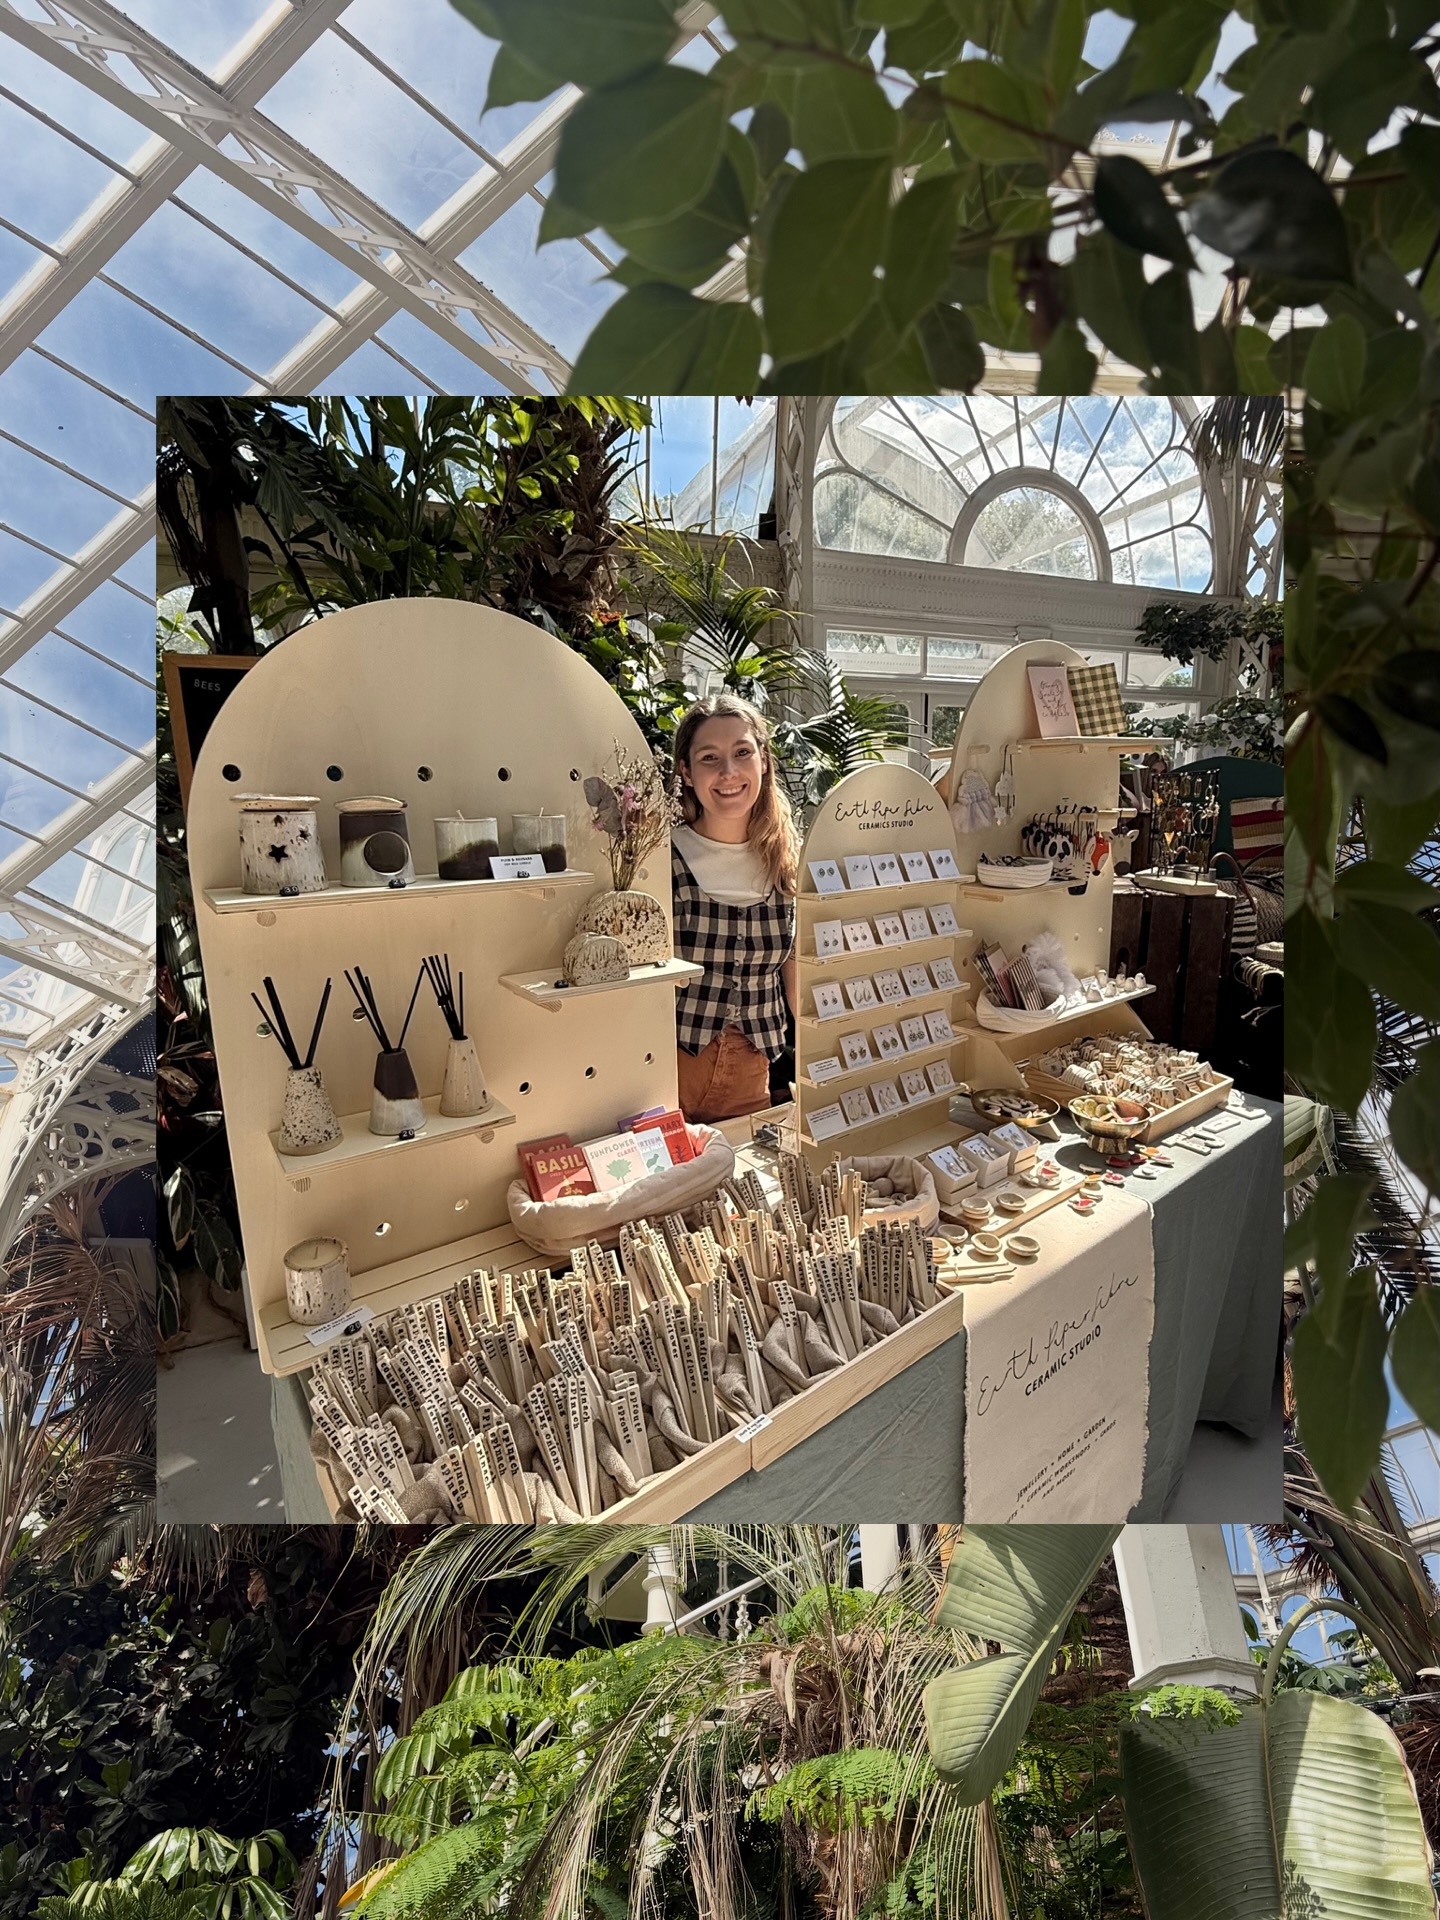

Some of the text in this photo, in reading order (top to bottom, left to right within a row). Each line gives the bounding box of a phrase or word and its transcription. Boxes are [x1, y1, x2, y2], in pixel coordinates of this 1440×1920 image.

[193, 678, 221, 692] BEES
[835, 800, 869, 821] Earth
[858, 819, 914, 831] CERAMICS STUDIO
[536, 1153, 584, 1175] BASIL
[589, 1138, 635, 1160] SUNFLOWER
[349, 1321, 361, 1332] 20
[434, 1303, 446, 1352] asparagus
[507, 1323, 517, 1343] dill
[664, 1304, 678, 1359] sunflower
[408, 1345, 433, 1388] courgette
[418, 1338, 441, 1383] courgette
[467, 1355, 479, 1375] dill
[484, 1338, 497, 1360] dill
[551, 1344, 572, 1378] parsnips
[683, 1338, 697, 1394] sunflower
[699, 1327, 709, 1382] sunflower
[1024, 1324, 1102, 1396] CERAMIC STUDIO
[381, 1362, 408, 1408] courgette
[977, 1337, 1039, 1417] Earth
[570, 1381, 580, 1430] spinach
[580, 1380, 591, 1422] spinach
[630, 1391, 643, 1433] sprouts
[388, 1429, 404, 1460] leeks
[530, 1393, 549, 1430] spring
[545, 1433, 562, 1471] onions
[617, 1405, 632, 1444] sprouts
[344, 1450, 364, 1478] leeks
[359, 1432, 376, 1462] leeks
[380, 1439, 396, 1470] leeks
[476, 1442, 492, 1490] spinach
[490, 1432, 507, 1477] spinach
[502, 1428, 520, 1476] spinach
[1016, 1416, 1106, 1502] JEWELLERY HOME GARDEN
[440, 1463, 464, 1511] spinach
[449, 1453, 469, 1500] spinach
[1026, 1474, 1053, 1502] CERAMIC
[1054, 1443, 1091, 1477] WORKSHOPS
